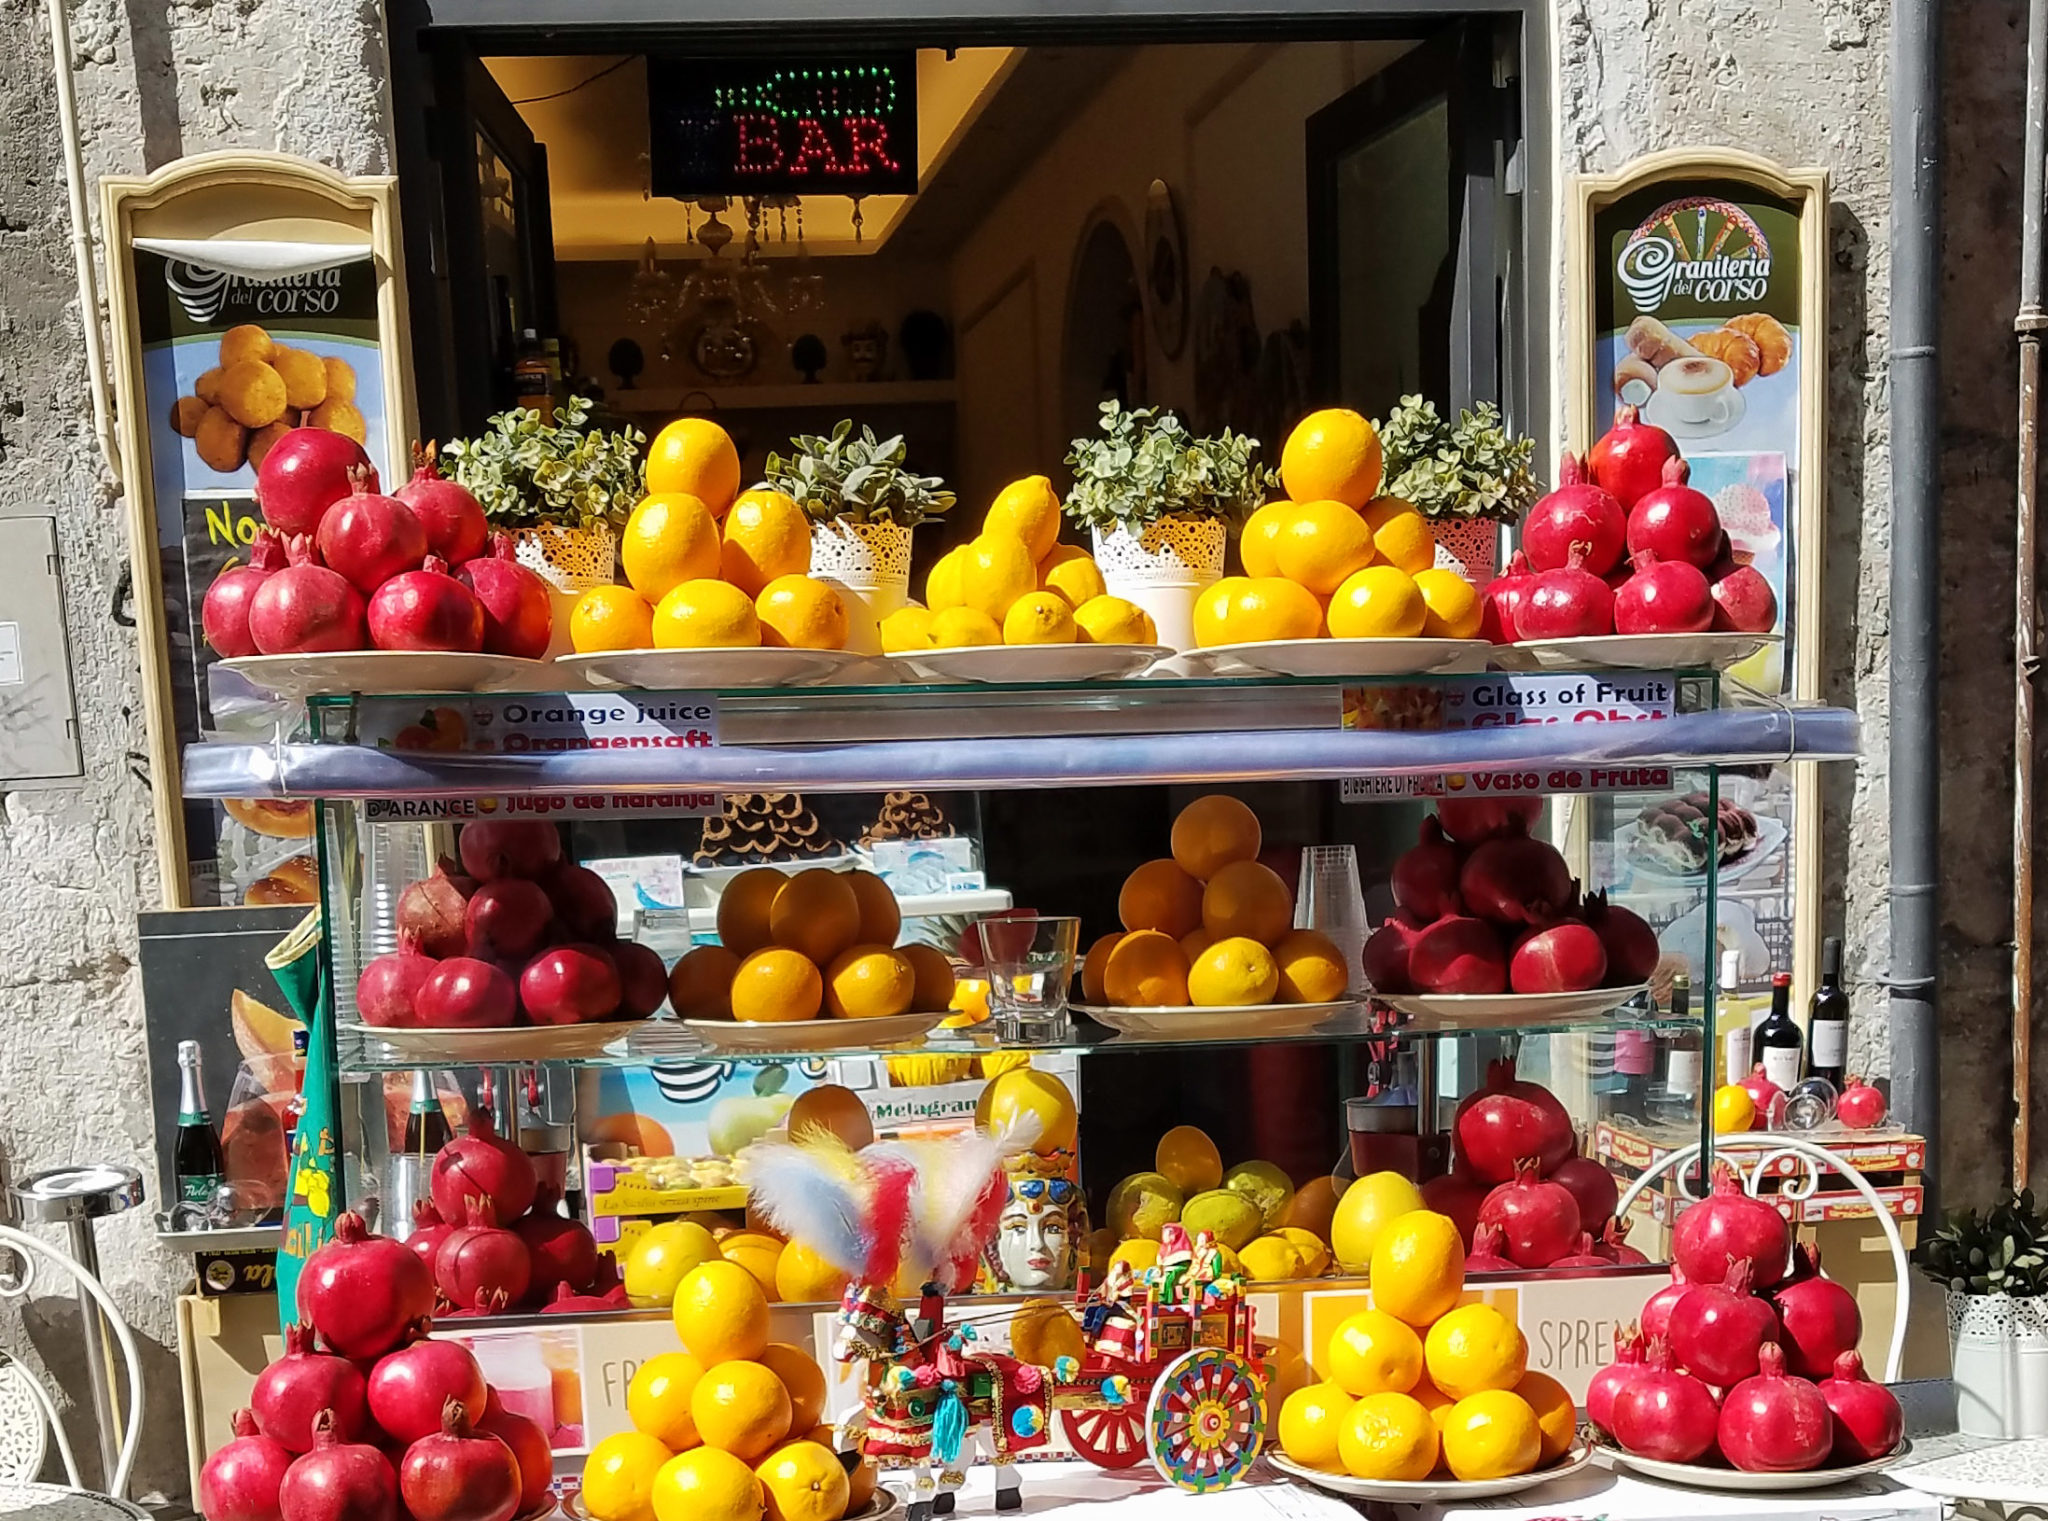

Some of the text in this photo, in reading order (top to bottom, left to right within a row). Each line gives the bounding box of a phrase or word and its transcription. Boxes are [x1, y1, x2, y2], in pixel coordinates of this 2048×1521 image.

[732, 114, 900, 173] BAR
[1617, 236, 1771, 313] Graniteria
[231, 287, 340, 314] del corso
[1673, 276, 1768, 303] del corso
[205, 500, 268, 549] No
[1473, 682, 1667, 707] Glass of Fruit
[503, 702, 711, 725] Orange juice
[1472, 768, 1669, 791] Vaso de Fruta
[612, 793, 716, 810] naranja
[1539, 1318, 1638, 1370] SPRE
[602, 1359, 646, 1411] FR
